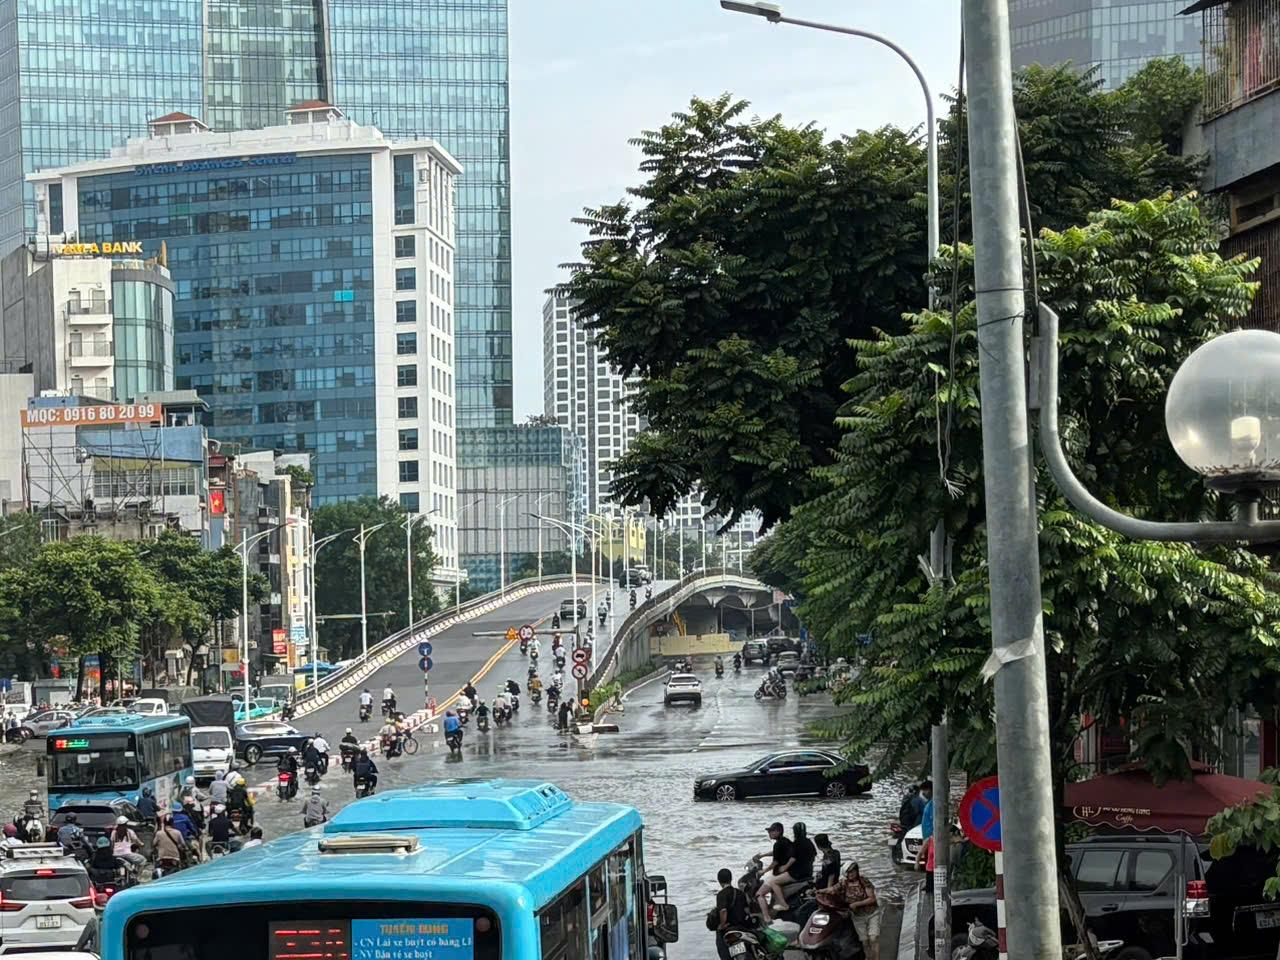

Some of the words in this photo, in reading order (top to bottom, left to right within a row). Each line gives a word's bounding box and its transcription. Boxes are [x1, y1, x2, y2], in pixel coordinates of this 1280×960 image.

[102, 241, 143, 254] BANK
[26, 409, 60, 424] MQC:
[63, 408, 96, 422] 0916
[99, 406, 115, 420] 80
[120, 405, 135, 419] 20
[138, 404, 155, 418] 99
